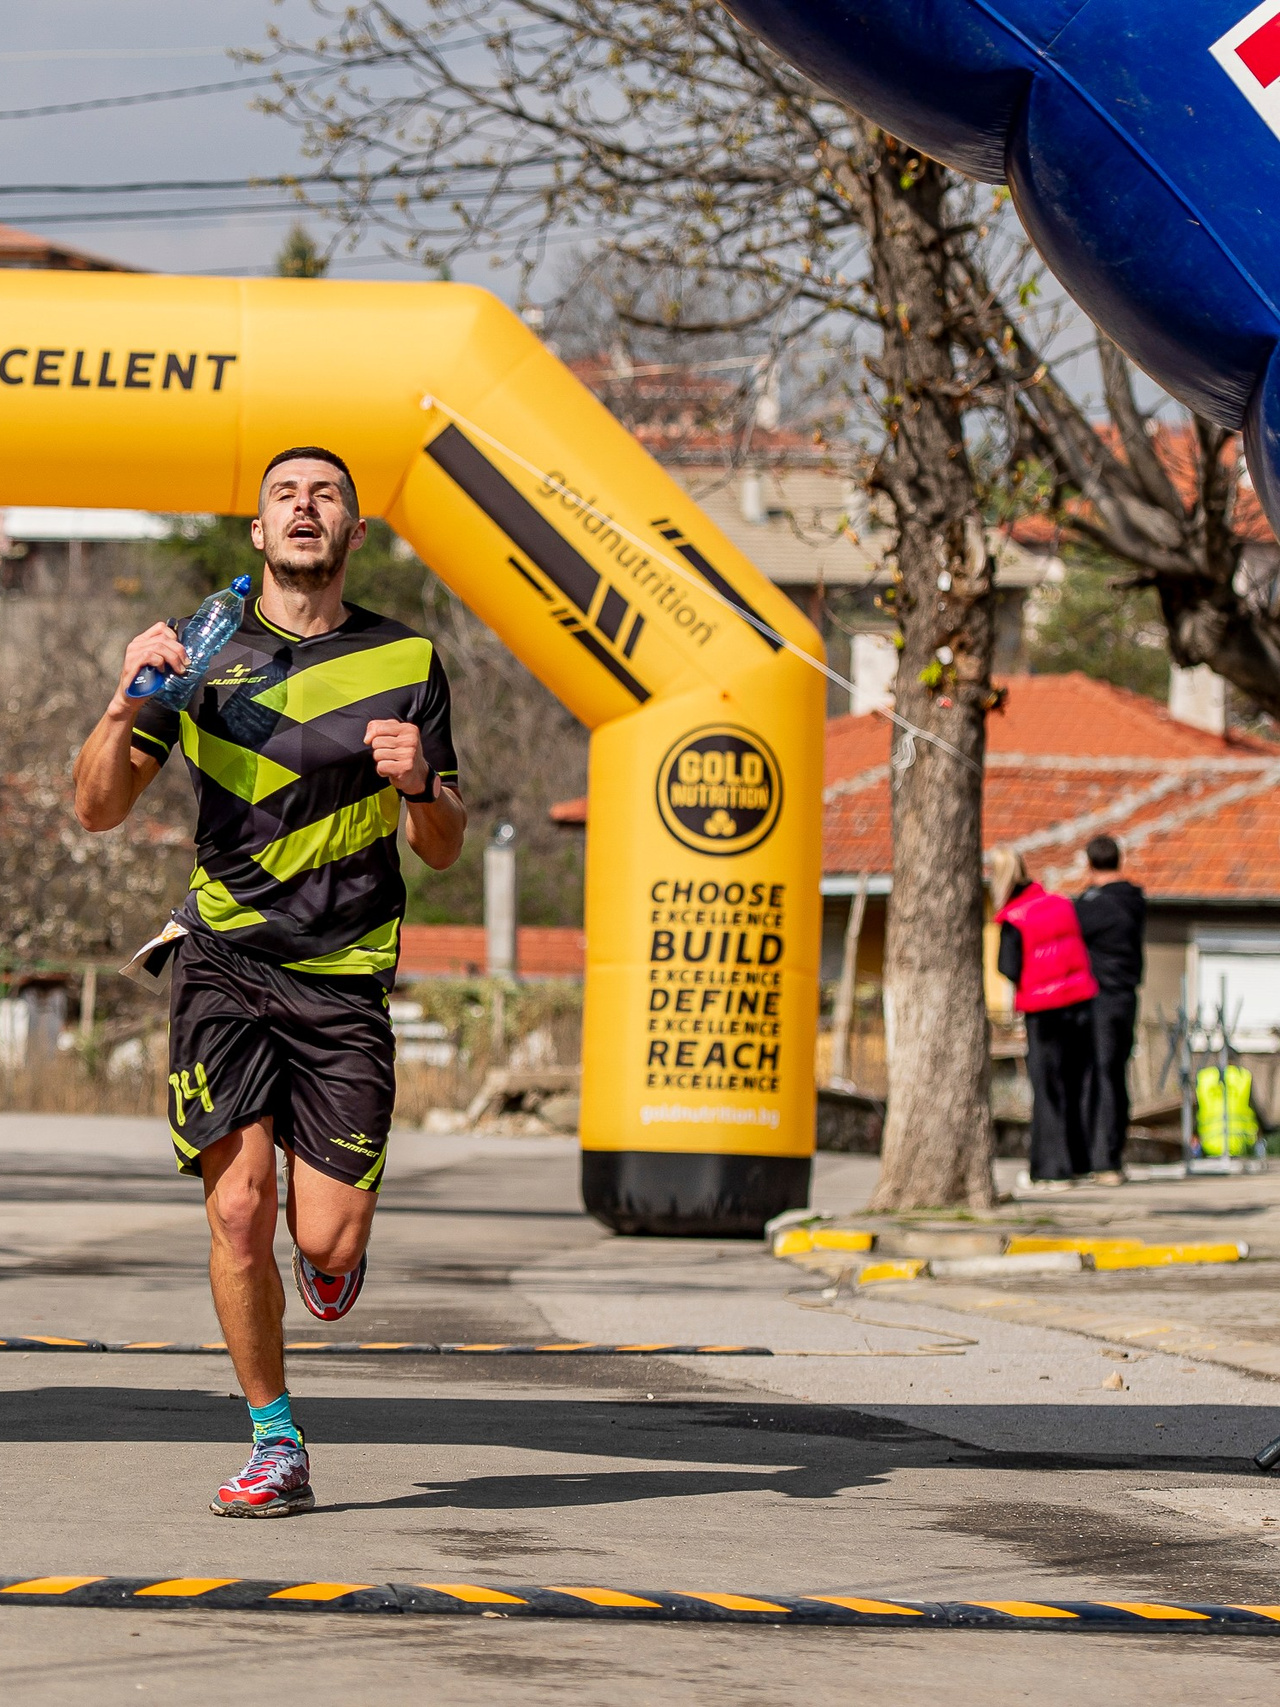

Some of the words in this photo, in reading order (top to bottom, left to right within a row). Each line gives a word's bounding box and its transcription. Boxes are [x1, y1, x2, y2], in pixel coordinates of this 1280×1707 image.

[536, 470, 716, 648] goldnutrition
[677, 749, 764, 787] GOLD
[670, 781, 769, 810] NUTRITION
[651, 880, 785, 908] CHOOSE
[651, 910, 783, 928] EXCELLENCE
[650, 930, 784, 965] BUILD
[649, 969, 781, 985] EXCELLENCE
[649, 989, 781, 1016] DEFINE
[648, 1019, 780, 1037] EXCELLENCE
[647, 1040, 780, 1071] REACH
[168, 1062, 215, 1127] 14
[647, 1074, 780, 1093] EXCELLENCE
